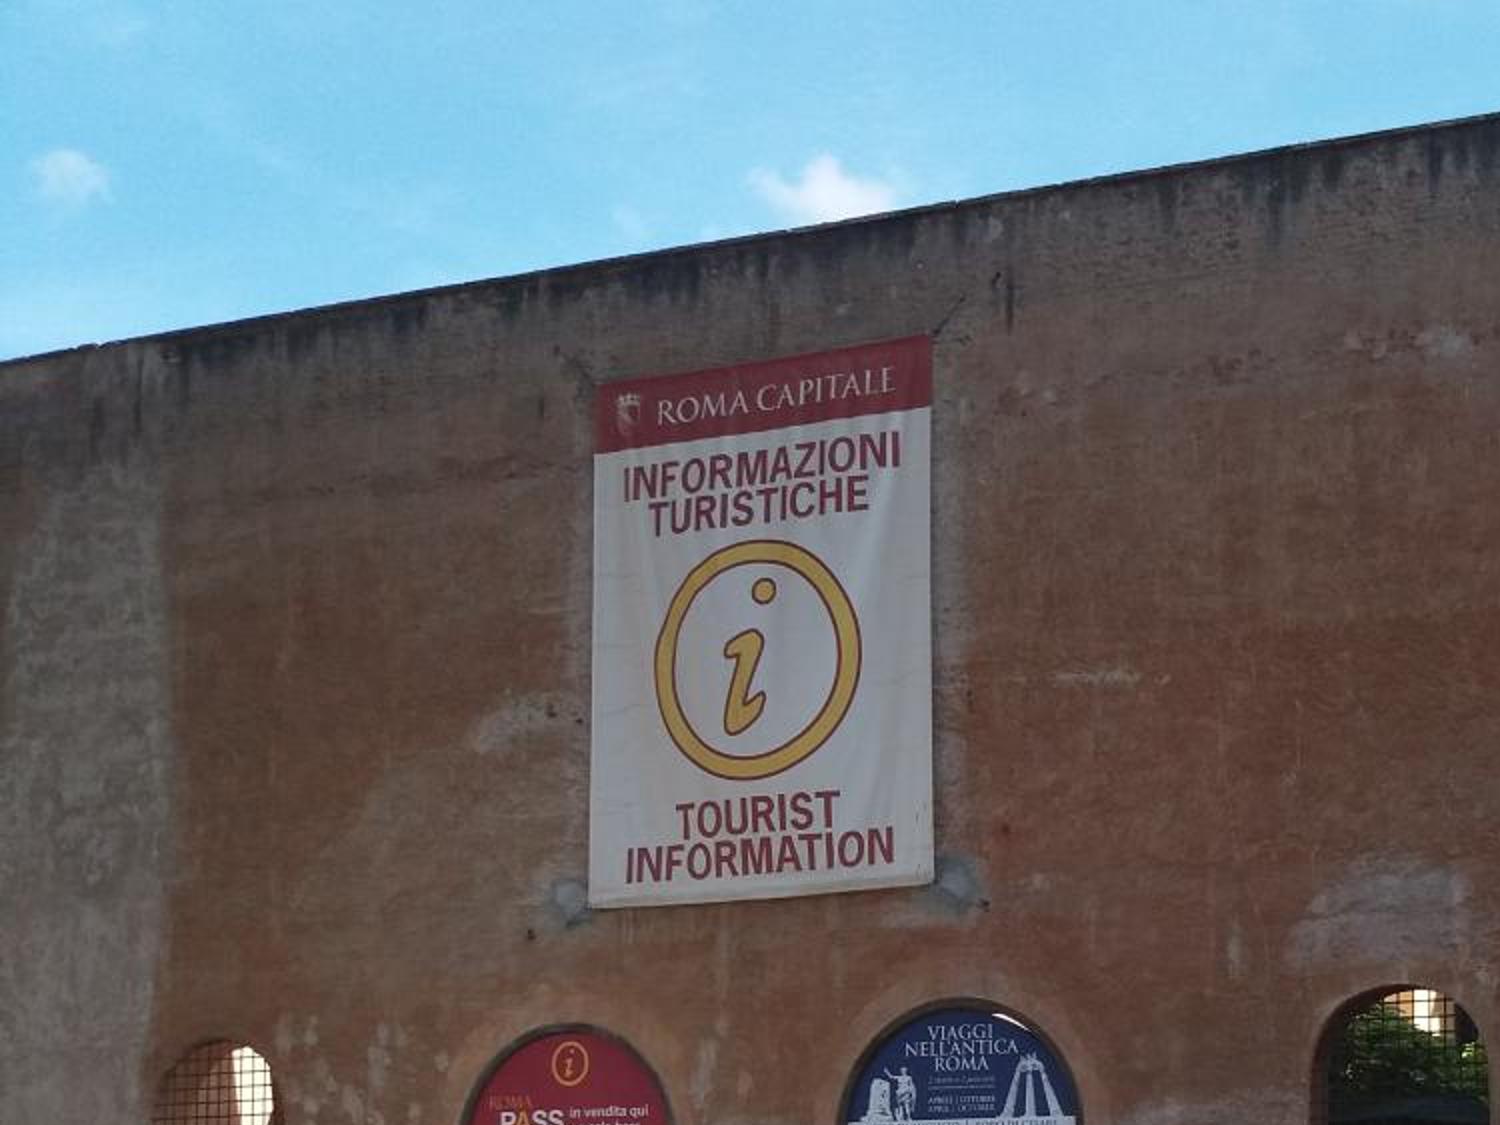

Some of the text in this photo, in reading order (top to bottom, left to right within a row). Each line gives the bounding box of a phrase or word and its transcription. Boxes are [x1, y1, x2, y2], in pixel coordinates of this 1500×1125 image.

[657, 367, 896, 426] ROMA CAPITALE
[623, 430, 901, 502] INFORMAZIONI
[648, 474, 870, 537] TURISTICHE
[675, 789, 841, 841] TOURIST
[625, 825, 895, 884] INFORMATION
[927, 1023, 993, 1040] VIAGGI
[935, 1056, 989, 1072] ROMA
[569, 1103, 650, 1118] in vendita qui
